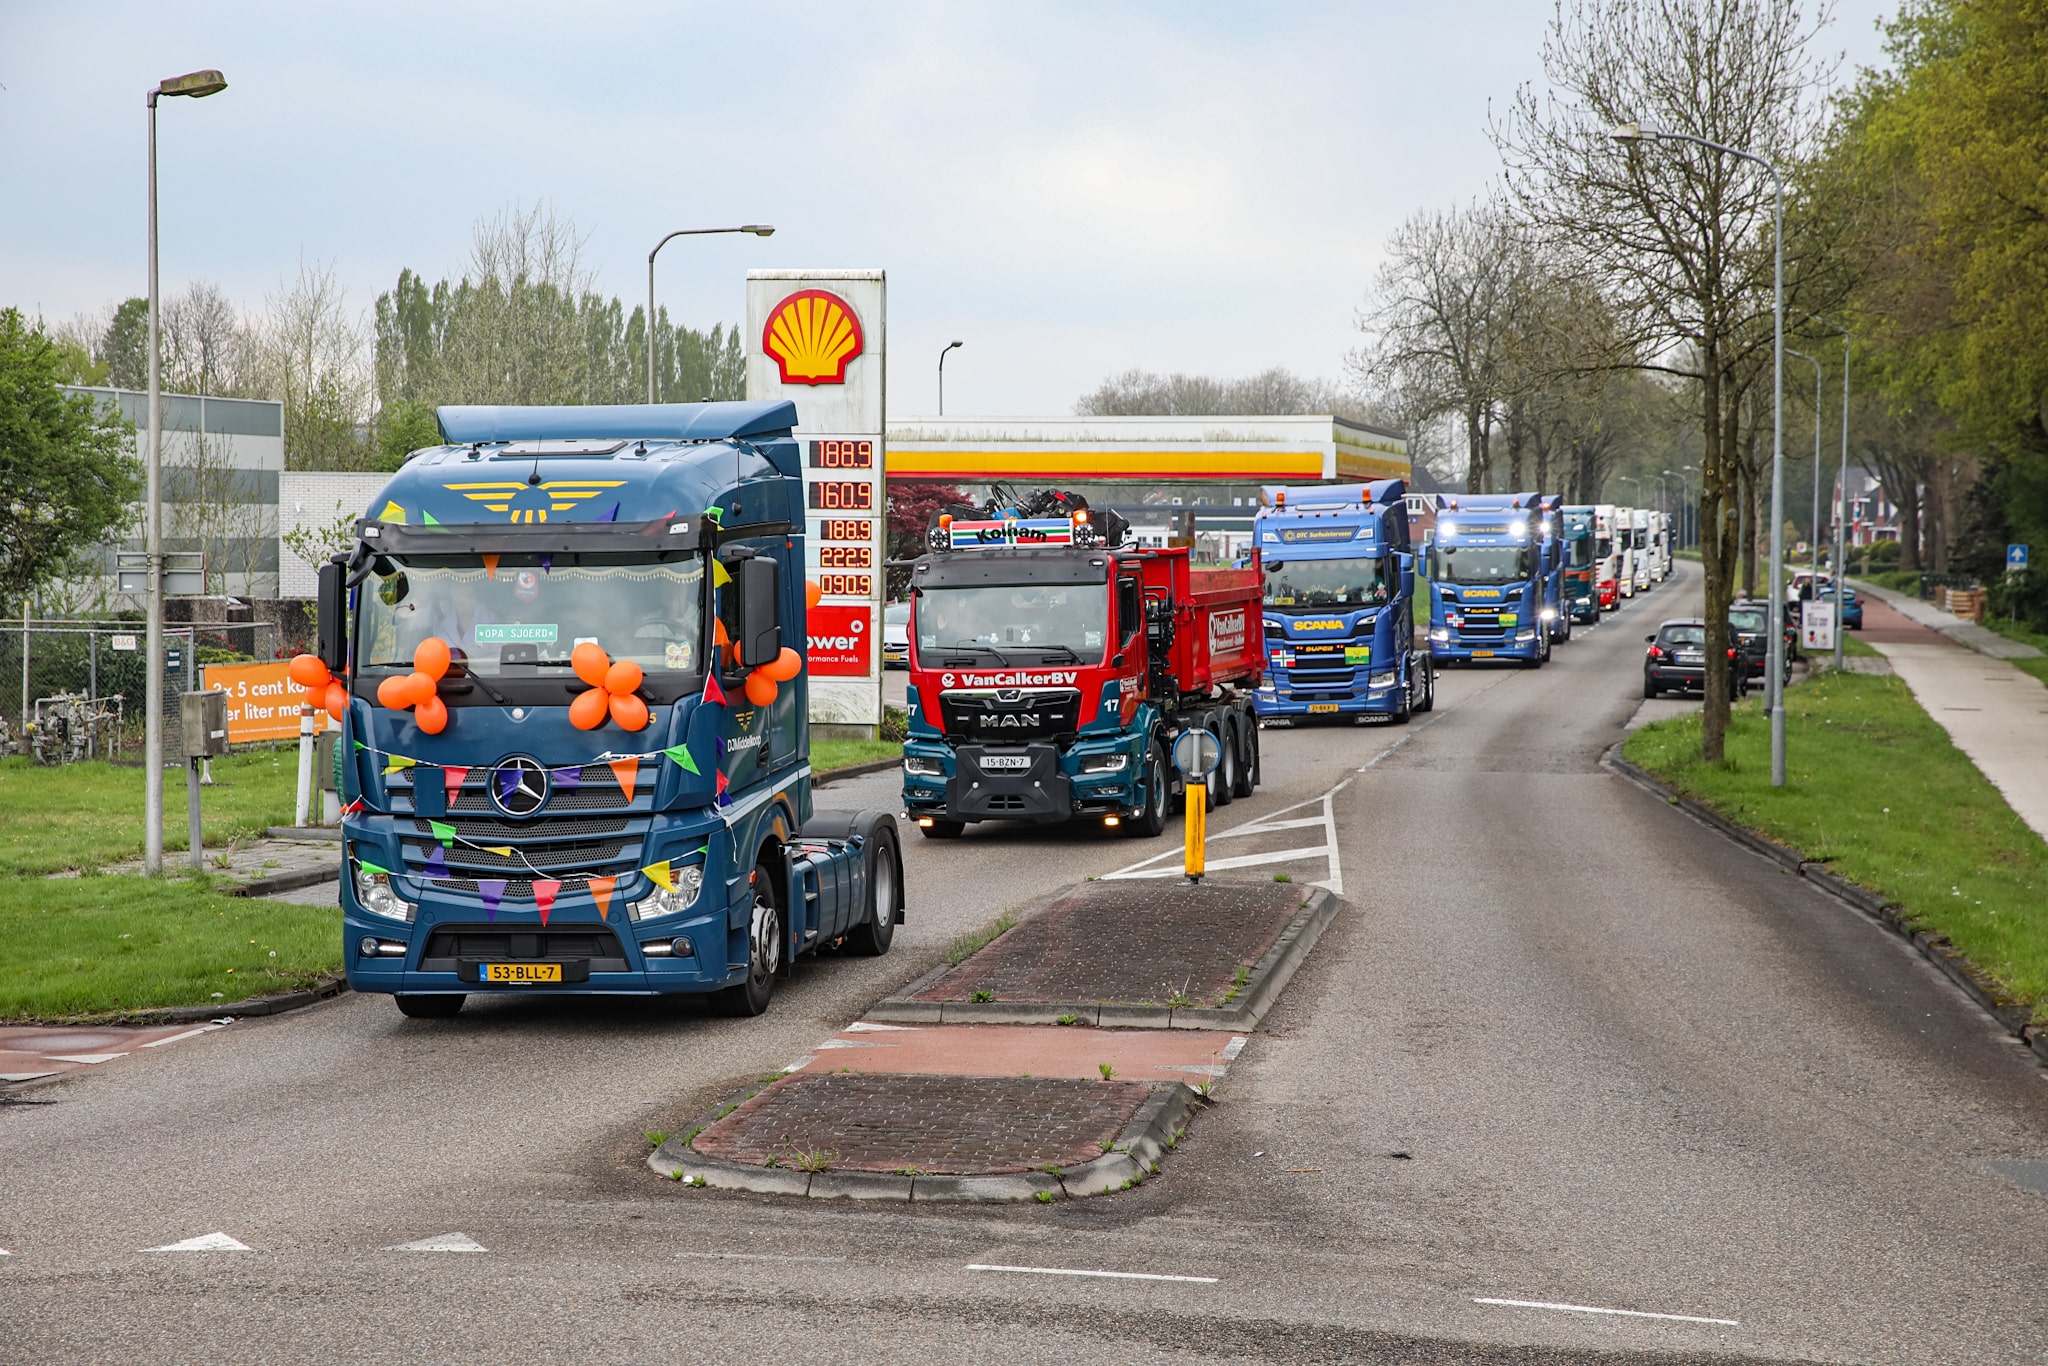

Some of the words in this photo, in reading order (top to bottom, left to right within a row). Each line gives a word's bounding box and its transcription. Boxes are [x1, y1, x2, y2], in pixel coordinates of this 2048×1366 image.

[819, 441, 871, 467] 188.9
[819, 483, 871, 508] 160.9
[828, 521, 871, 540] 188.9
[976, 524, 1047, 544] Kolham
[821, 548, 871, 567] 222.9
[821, 575, 871, 594] 090.9
[1463, 589, 1501, 598] SCANIA
[485, 628, 504, 638] OPA
[510, 628, 548, 638] SJOERD
[1293, 620, 1345, 631] SCANIA
[114, 637, 134, 646] B&G
[807, 635, 859, 651] ower
[807, 654, 839, 663] ormance
[840, 654, 859, 663] Fuels
[961, 671, 1078, 687] VanCalkerBV
[237, 681, 247, 698] 5
[251, 680, 283, 696] cent
[226, 708, 241, 722] er
[244, 702, 274, 720] liter
[1104, 698, 1120, 713] 17
[980, 714, 1040, 728] MAN
[1358, 715, 1389, 723] SCANIA
[986, 757, 1024, 767] 15-BZN-7
[493, 966, 554, 979] 53-BLL-7
